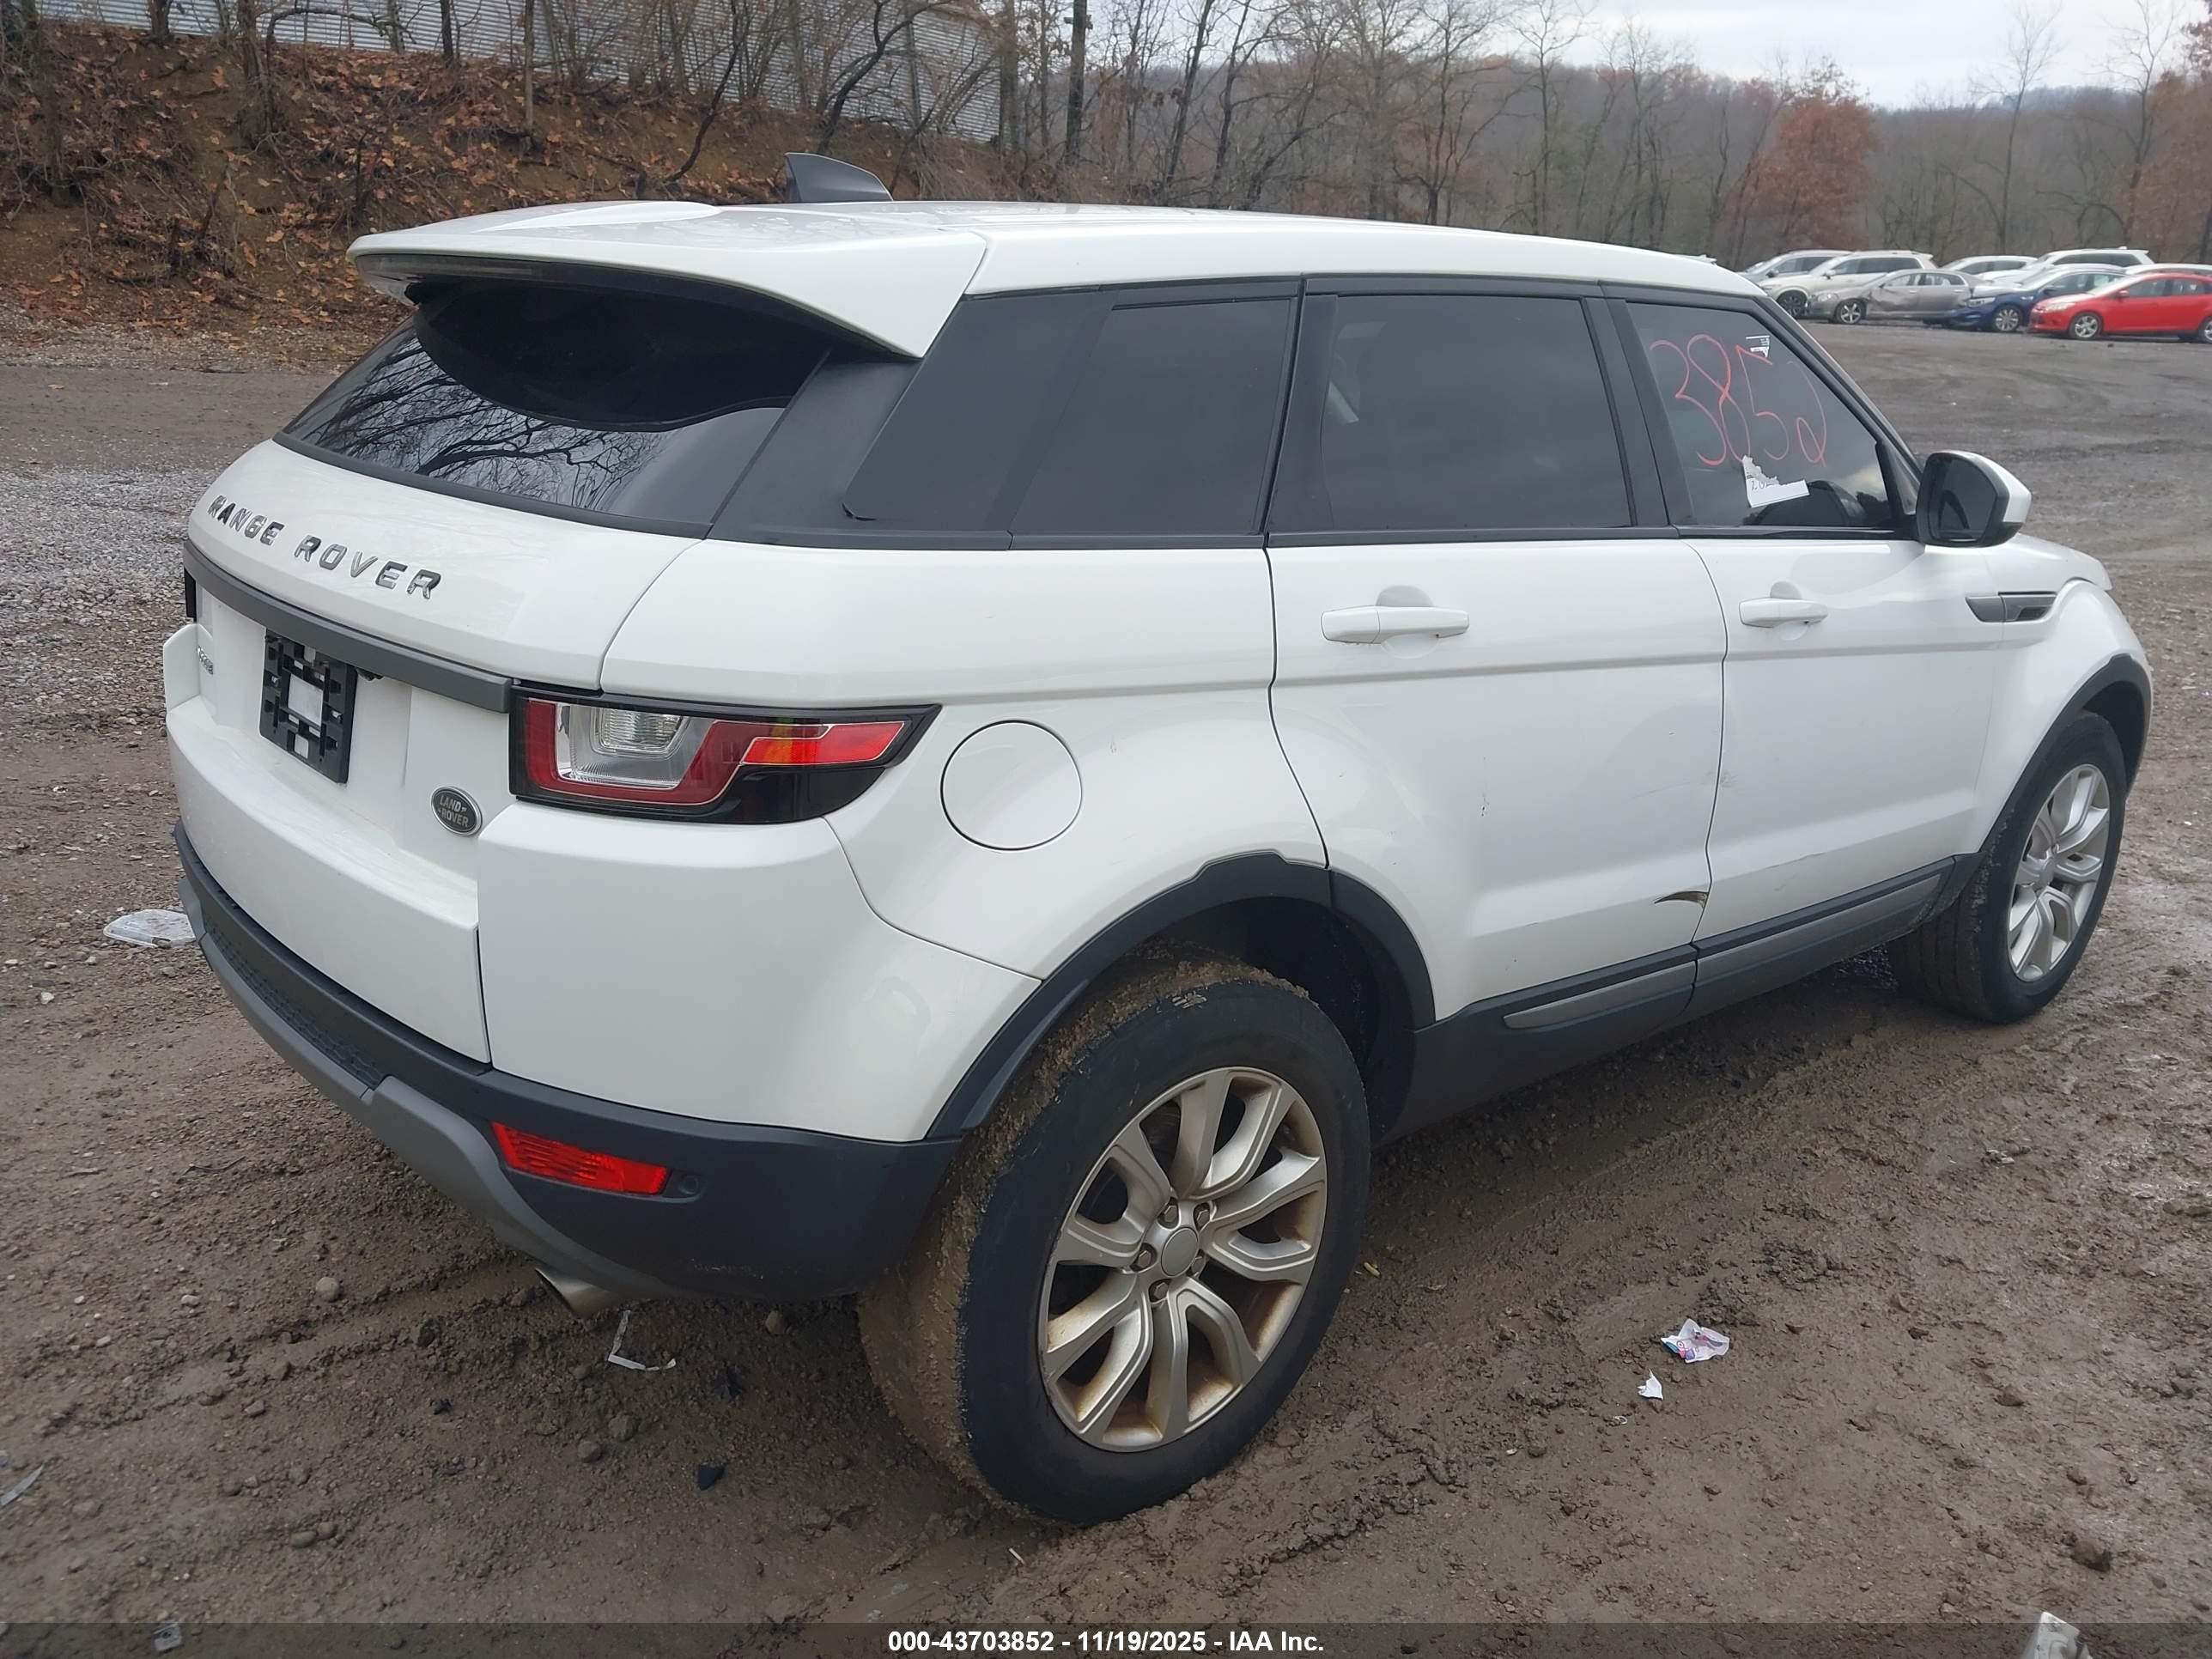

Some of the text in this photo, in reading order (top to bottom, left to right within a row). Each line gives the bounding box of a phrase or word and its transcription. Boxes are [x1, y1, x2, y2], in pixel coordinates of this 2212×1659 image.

[1649, 334, 1826, 468] 3852
[208, 495, 441, 600] RANGE ROVER
[439, 794, 462, 812] LAND
[441, 807, 469, 828] ROVER
